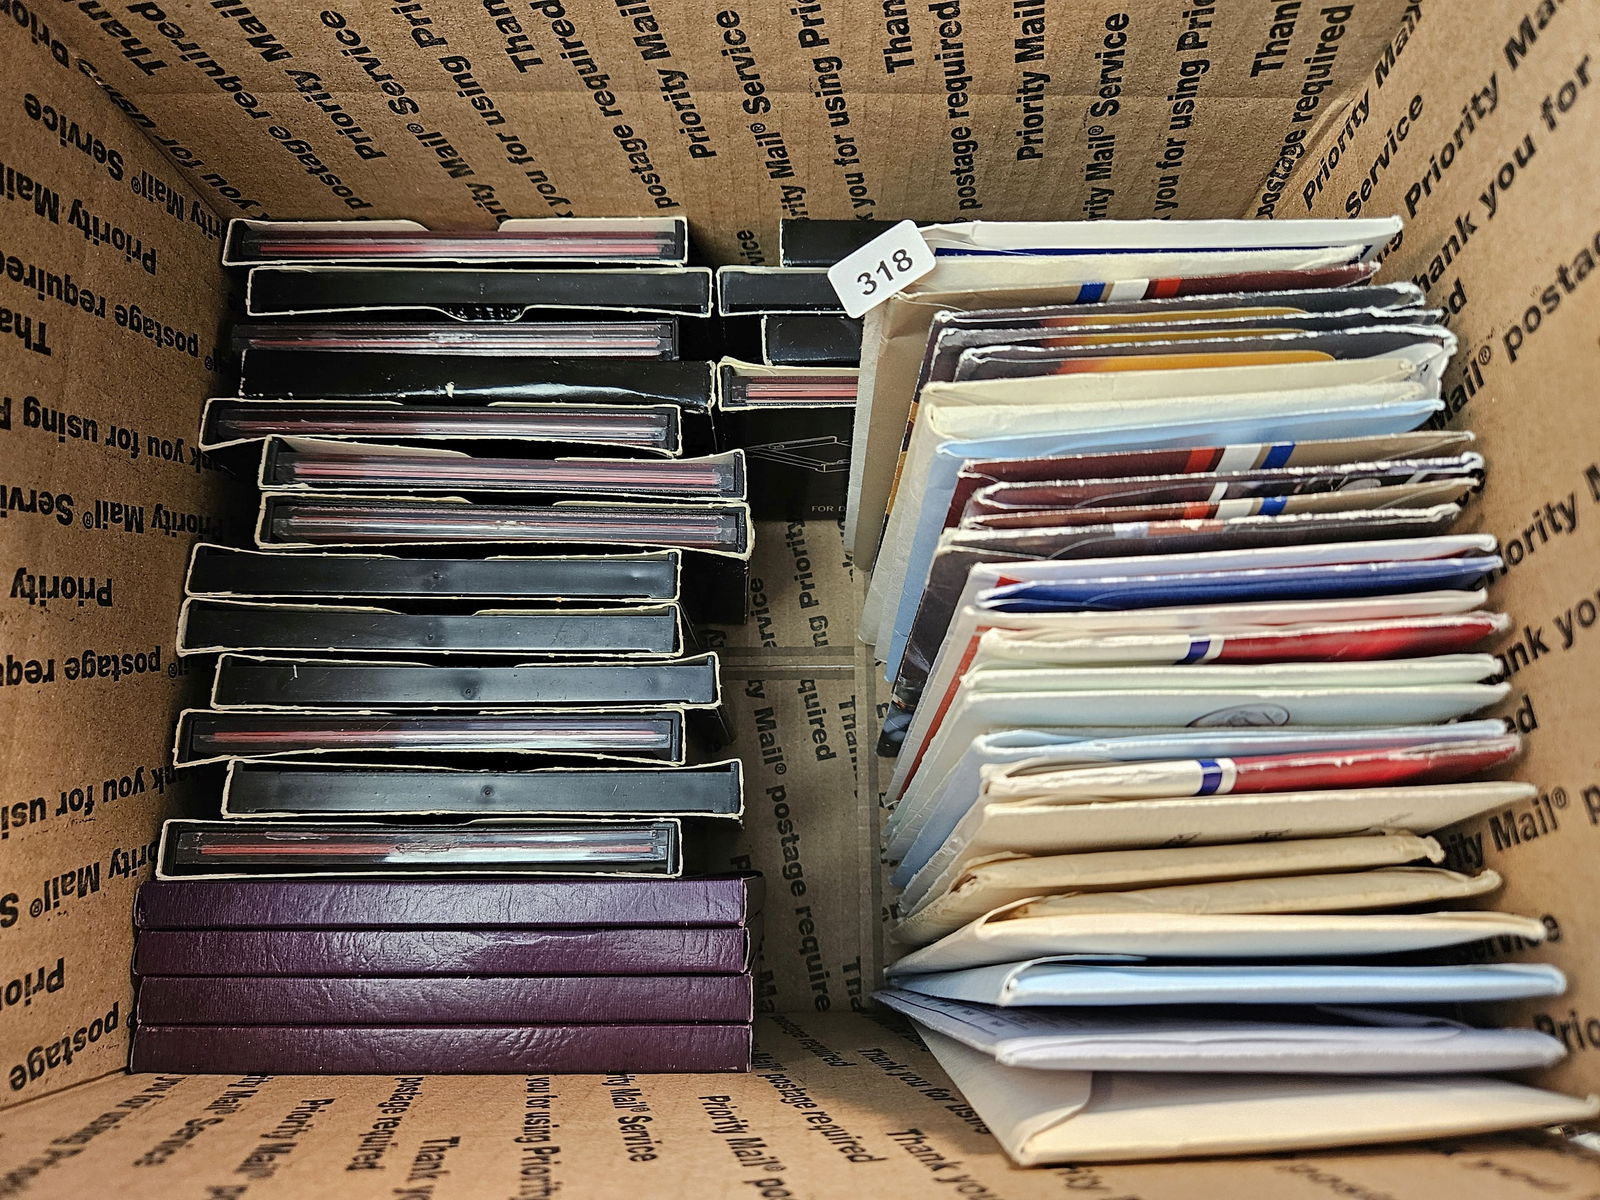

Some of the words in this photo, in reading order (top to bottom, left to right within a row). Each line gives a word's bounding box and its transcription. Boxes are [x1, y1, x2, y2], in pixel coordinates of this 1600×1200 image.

[66, 0, 169, 76] Than
[126, 2, 272, 119] required
[319, 10, 420, 116] Service
[529, 1, 624, 118] required
[715, 9, 771, 116] Service
[928, 2, 973, 120] required
[1090, 12, 1130, 118] Service
[1250, 0, 1301, 77] Than
[1292, 5, 1353, 124] required
[284, 69, 388, 160] Priority
[438, 55, 506, 127] using
[656, 69, 718, 160] Priority
[811, 55, 851, 127] using
[1015, 71, 1051, 161] Priority
[1167, 58, 1210, 130] using
[24, 93, 124, 181] Service
[495, 132, 536, 166] for
[833, 134, 862, 167] for
[1155, 137, 1187, 170] for
[1302, 88, 1370, 210] Priority
[1344, 93, 1424, 220] Service
[1404, 72, 1500, 219] Priority
[201, 173, 262, 210] you
[268, 125, 374, 210] postage
[525, 169, 574, 208] you
[612, 124, 680, 210] postage
[844, 172, 876, 210] you
[949, 125, 983, 212] postage
[1153, 174, 1181, 212] you
[1411, 210, 1479, 294] hank
[1478, 133, 1537, 220] you
[1540, 53, 1592, 133] for
[67, 199, 157, 276] Priority
[190, 200, 223, 240] rity
[737, 229, 765, 266] vice
[856, 248, 914, 296] 318
[114, 304, 200, 358] postage
[23, 396, 98, 443] using
[105, 425, 141, 459] for
[147, 435, 185, 463] you
[10, 567, 113, 607] Priority
[0, 654, 55, 687] req
[64, 646, 161, 682] postage
[797, 680, 837, 762] quired
[55, 785, 95, 816] for
[103, 766, 145, 803] you
[765, 784, 806, 897] postage
[795, 906, 831, 1012] require
[0, 957, 65, 1011] Prio
[9, 1000, 119, 1092] postage
[377, 1076, 424, 1115] postage
[525, 1094, 559, 1110] for
[526, 1075, 550, 1093] you
[260, 1098, 335, 1139] Priority
[514, 1111, 560, 1143] using
[616, 1115, 663, 1162] Service
[698, 1095, 749, 1134] Priority
[757, 1073, 818, 1109] postage
[801, 1111, 889, 1163] required
[345, 1116, 402, 1171] required
[406, 1136, 461, 1183] Thank
[886, 1128, 963, 1172] Thank
